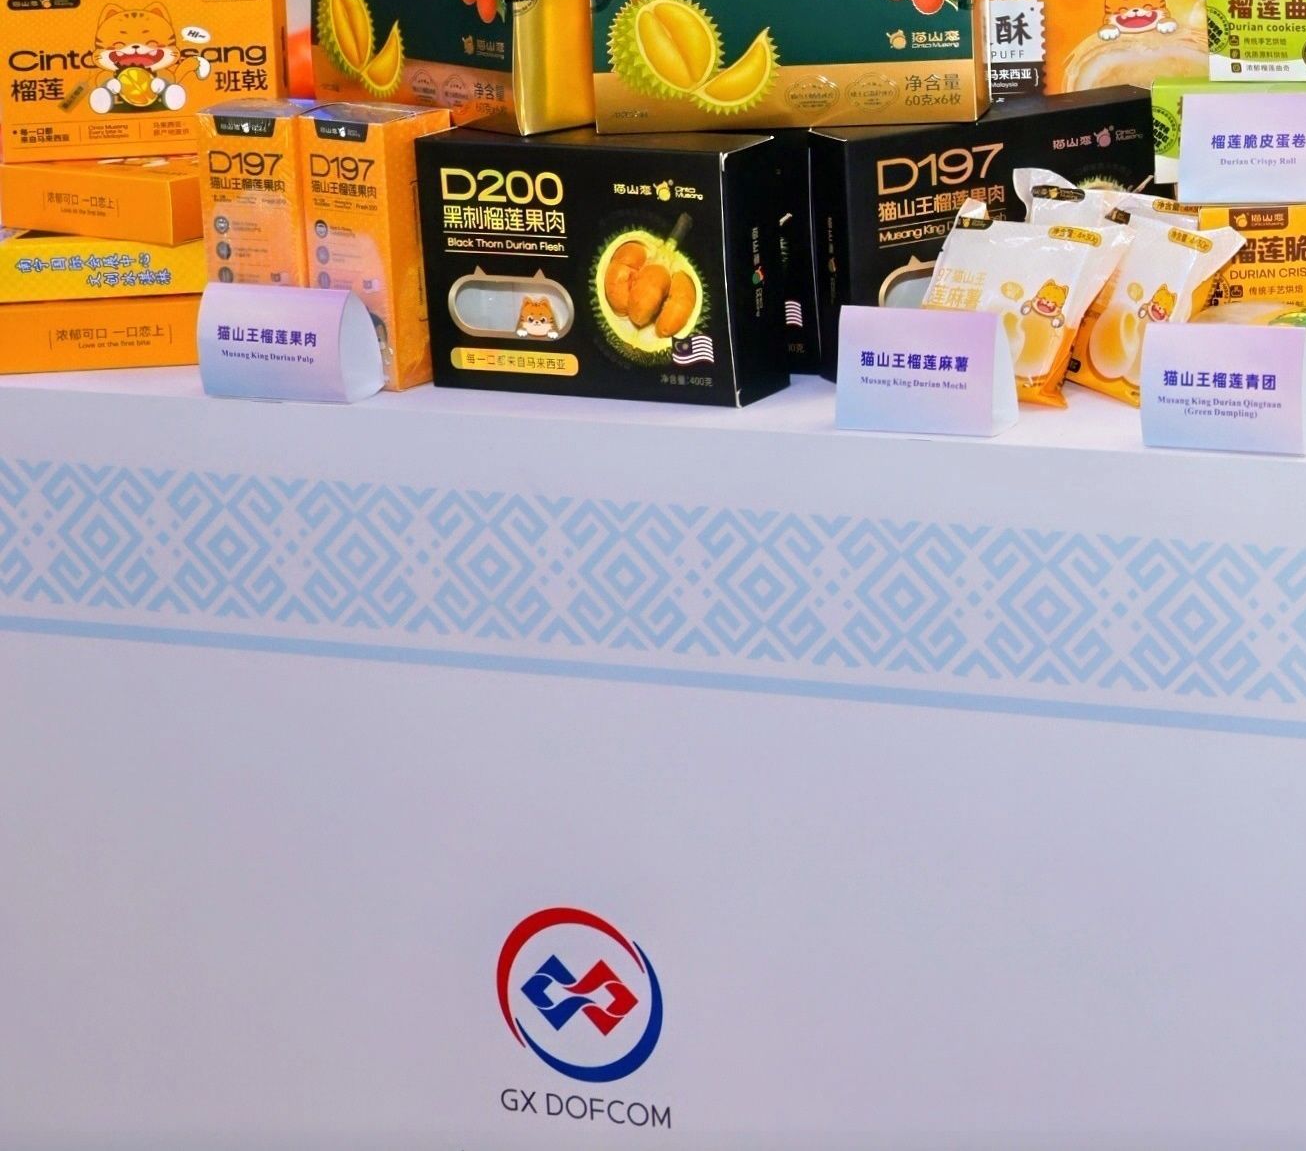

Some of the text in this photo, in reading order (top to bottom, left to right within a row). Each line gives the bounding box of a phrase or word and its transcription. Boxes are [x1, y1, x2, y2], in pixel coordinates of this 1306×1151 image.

[1228, 21, 1306, 33] Durian cookies
[10, 78, 65, 102] 榴莲
[215, 69, 268, 92] 班戟
[904, 73, 961, 93] 净含量
[1210, 134, 1306, 150] 榴莲脆皮蛋卷
[208, 150, 283, 176] D197
[310, 154, 375, 181] D197
[877, 143, 1004, 196] D197
[1250, 157, 1278, 168] Crispy
[209, 177, 285, 192] 猫山王榴莲果肉
[311, 180, 377, 199] 猫山王榴莲果肉
[440, 167, 564, 206] D200
[442, 204, 566, 234] 黑刺榴莲果肉
[878, 226, 923, 243] Musang
[447, 237, 565, 252] Black Thorn Durian Flesh
[1229, 268, 1276, 280] DURIAN
[55, 328, 108, 341] 浓郁可口
[217, 324, 318, 348] 猫山王榴莲果肉
[221, 349, 315, 365] Musang Durian Pulp
[861, 350, 969, 372] 猫山王榴莲麻薯
[941, 380, 967, 390] Mochi
[1163, 369, 1277, 392] 猫山王榴莲青团
[1211, 408, 1258, 420] Dumpling)
[500, 1088, 672, 1130] GX DOFCOM
